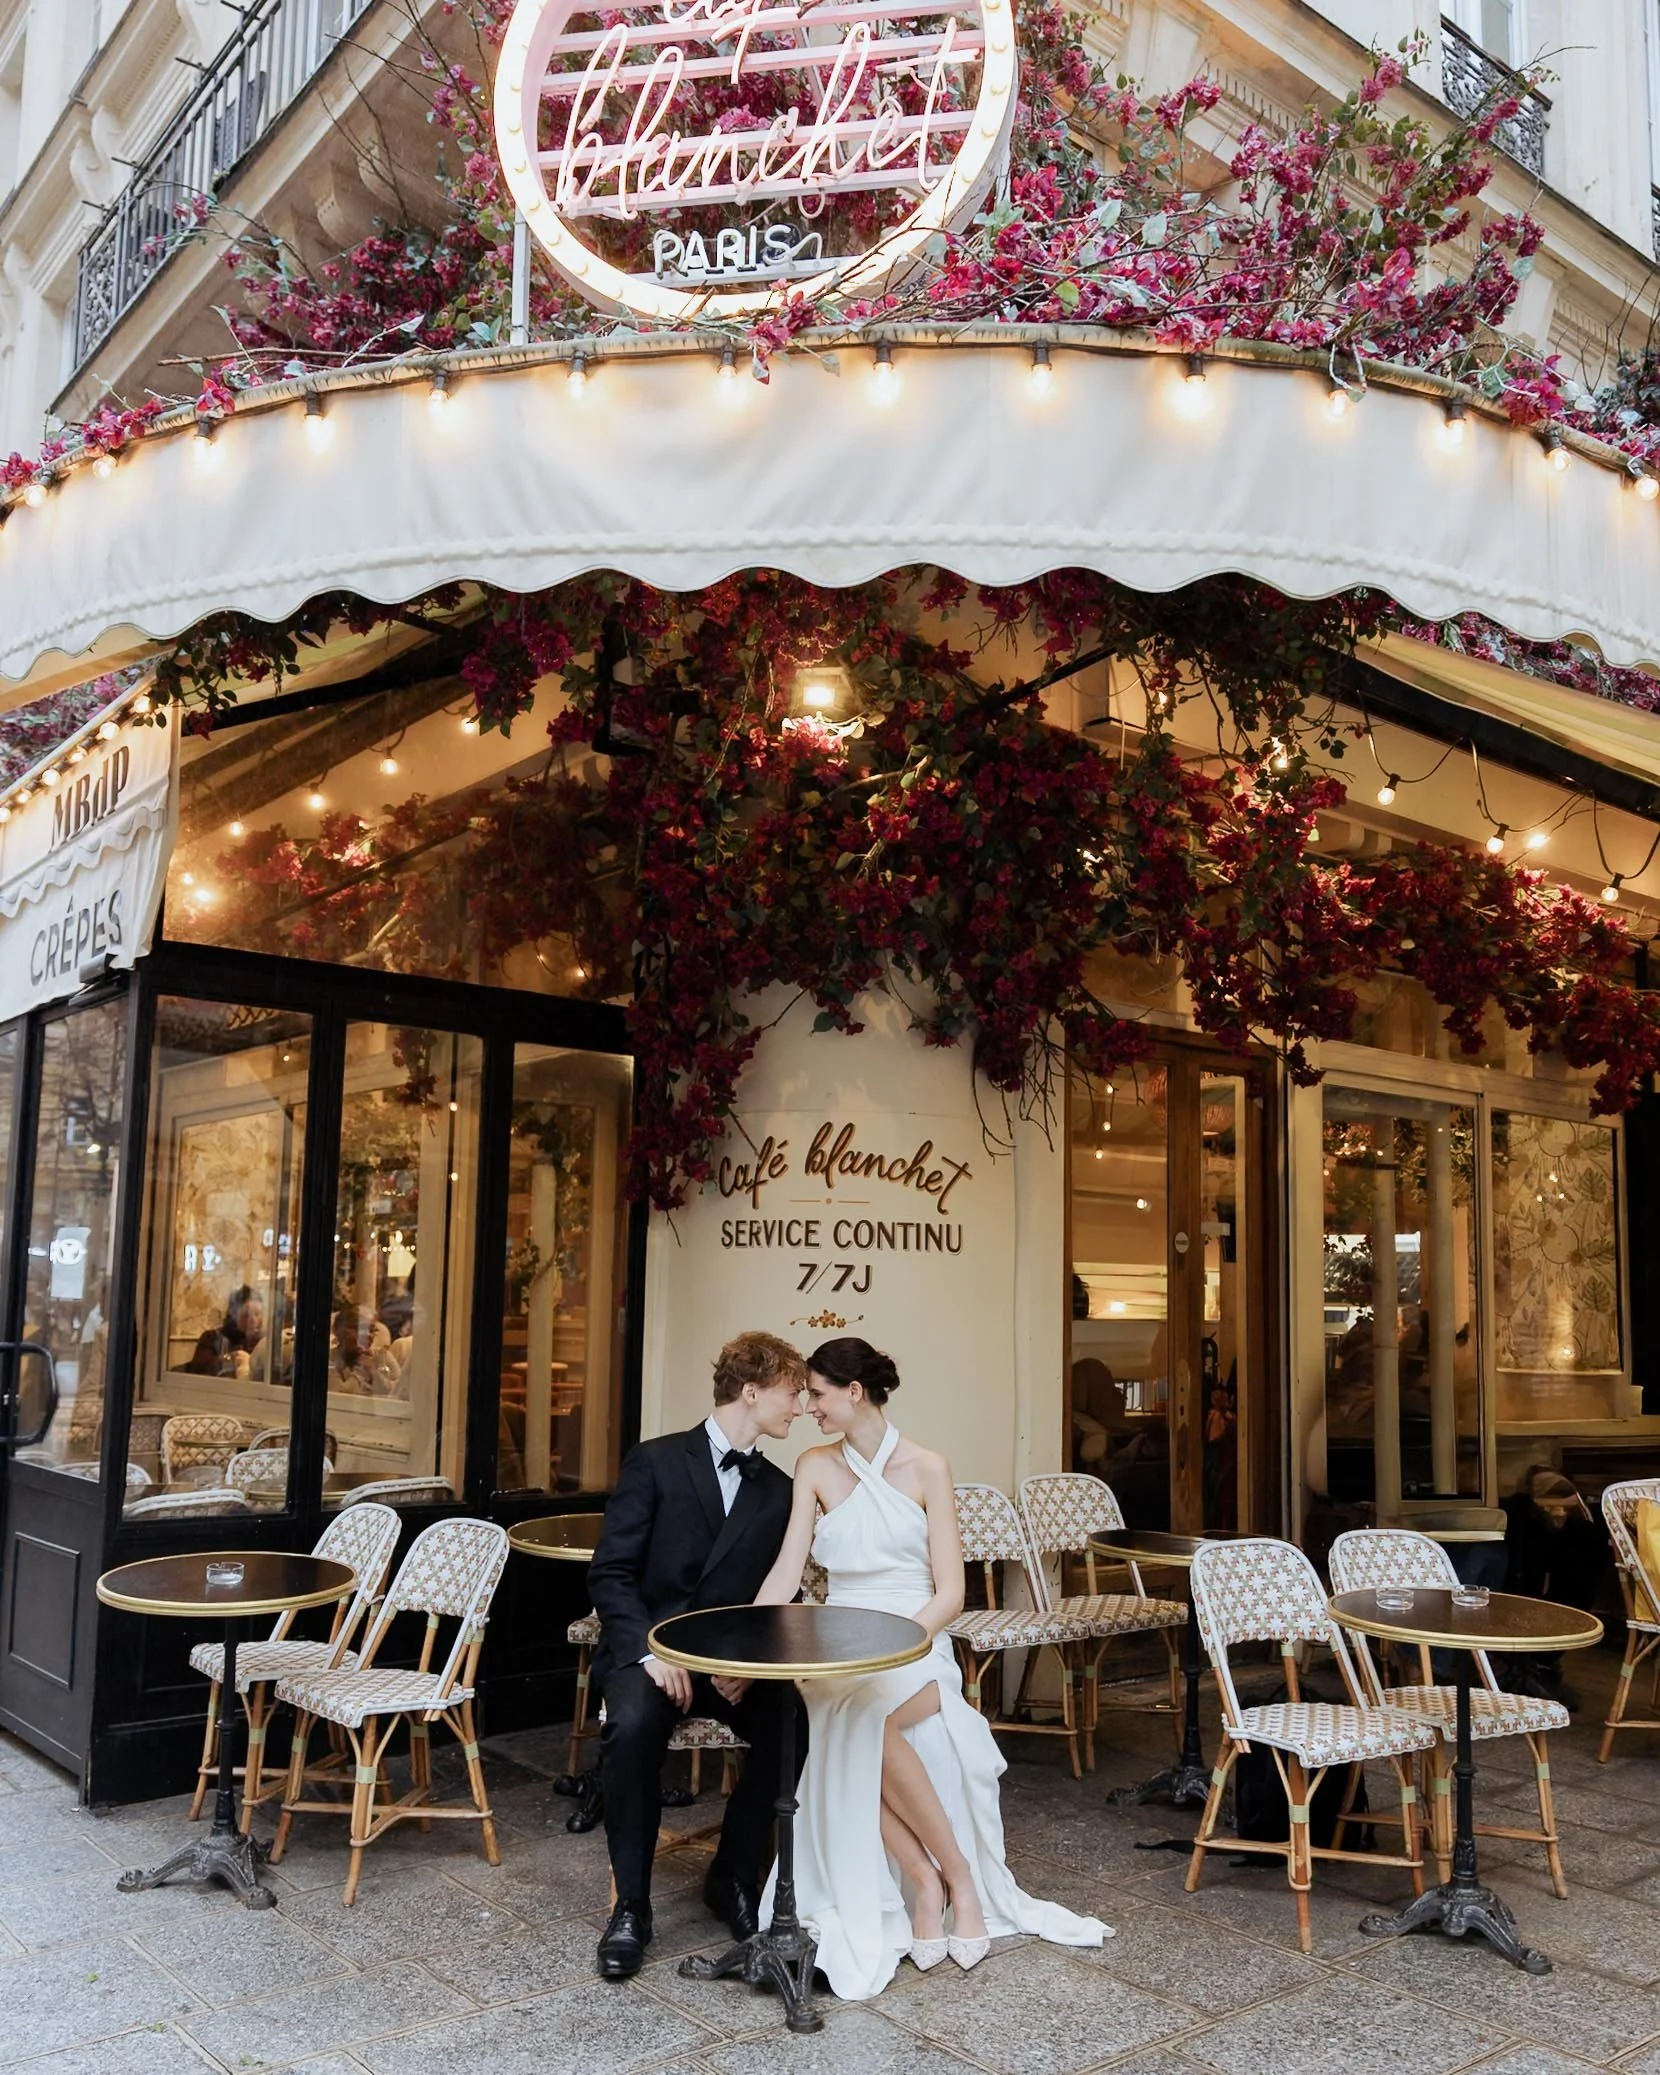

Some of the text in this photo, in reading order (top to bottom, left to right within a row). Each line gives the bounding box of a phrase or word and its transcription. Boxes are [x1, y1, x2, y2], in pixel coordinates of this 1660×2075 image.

[556, 18, 983, 220] blanchet
[653, 223, 796, 279] PARIS
[719, 1121, 973, 1215] Café blanchet
[721, 1219, 963, 1255] SERVICE CONTINU
[796, 1260, 872, 1294] 7/7J
